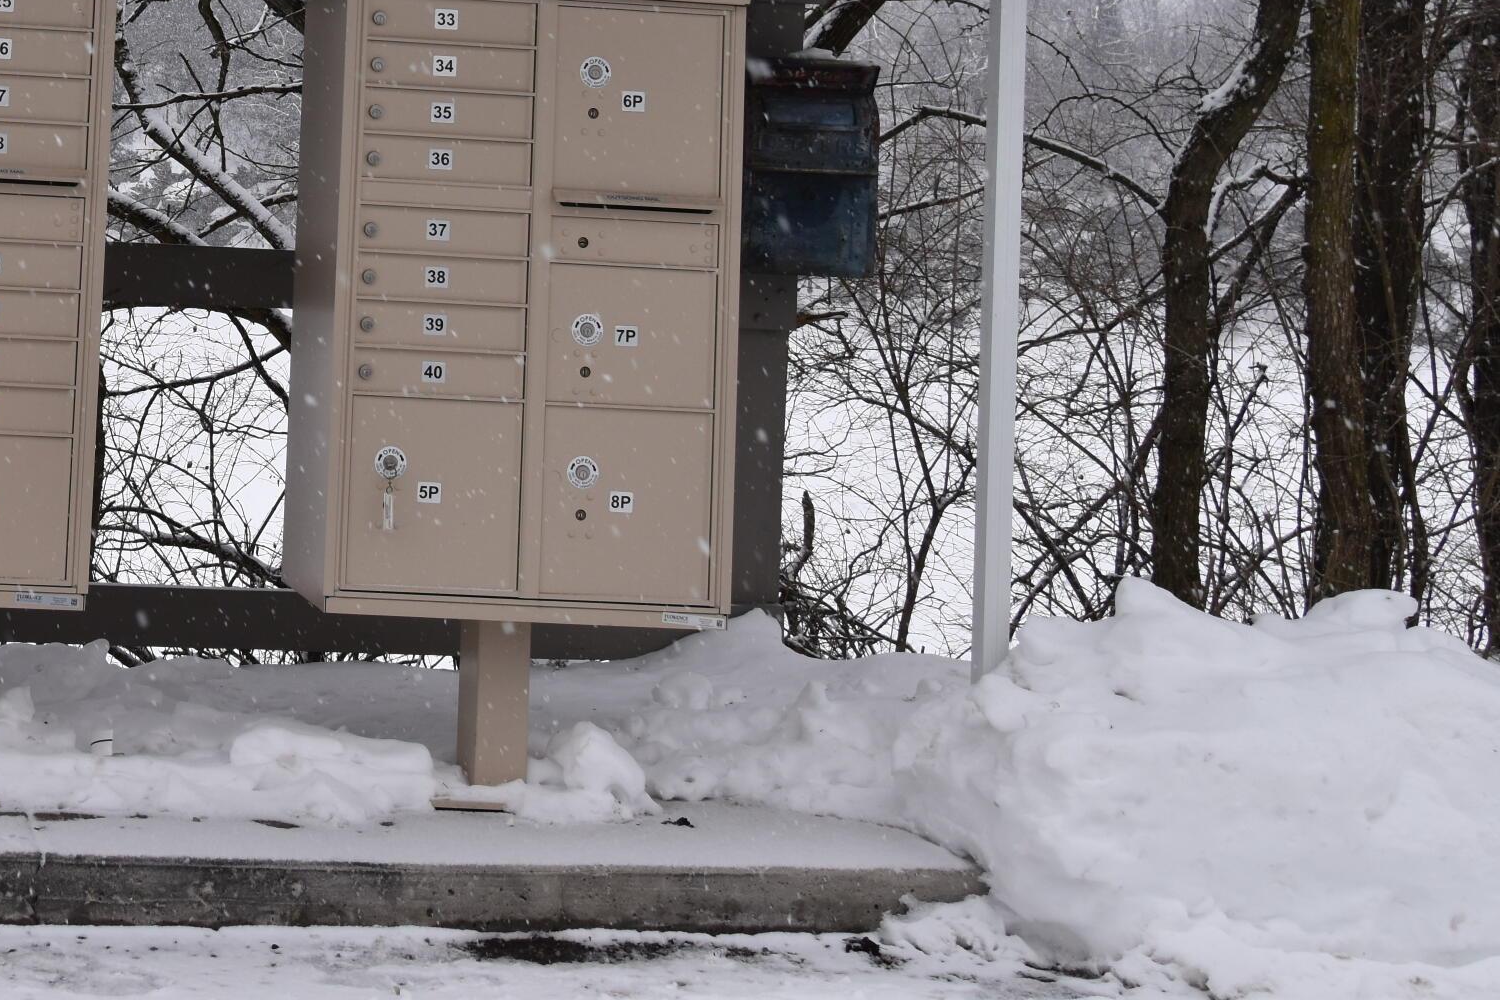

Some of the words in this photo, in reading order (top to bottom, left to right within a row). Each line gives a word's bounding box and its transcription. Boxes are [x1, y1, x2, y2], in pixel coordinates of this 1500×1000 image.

[437, 12, 455, 26] 33
[435, 59, 454, 73] 34
[588, 58, 606, 67] OPEN
[623, 94, 643, 108] 6P
[433, 105, 452, 120] 35
[431, 152, 450, 166] 36
[428, 222, 447, 237] 37
[427, 269, 446, 284] 38
[425, 317, 444, 332] 39
[579, 315, 596, 324] OPEN
[616, 329, 636, 343] 7P
[423, 365, 443, 379] 40
[382, 447, 399, 456] OPEN
[575, 458, 592, 466] OPEN
[419, 485, 439, 499] 5P
[610, 495, 631, 509] 8P
